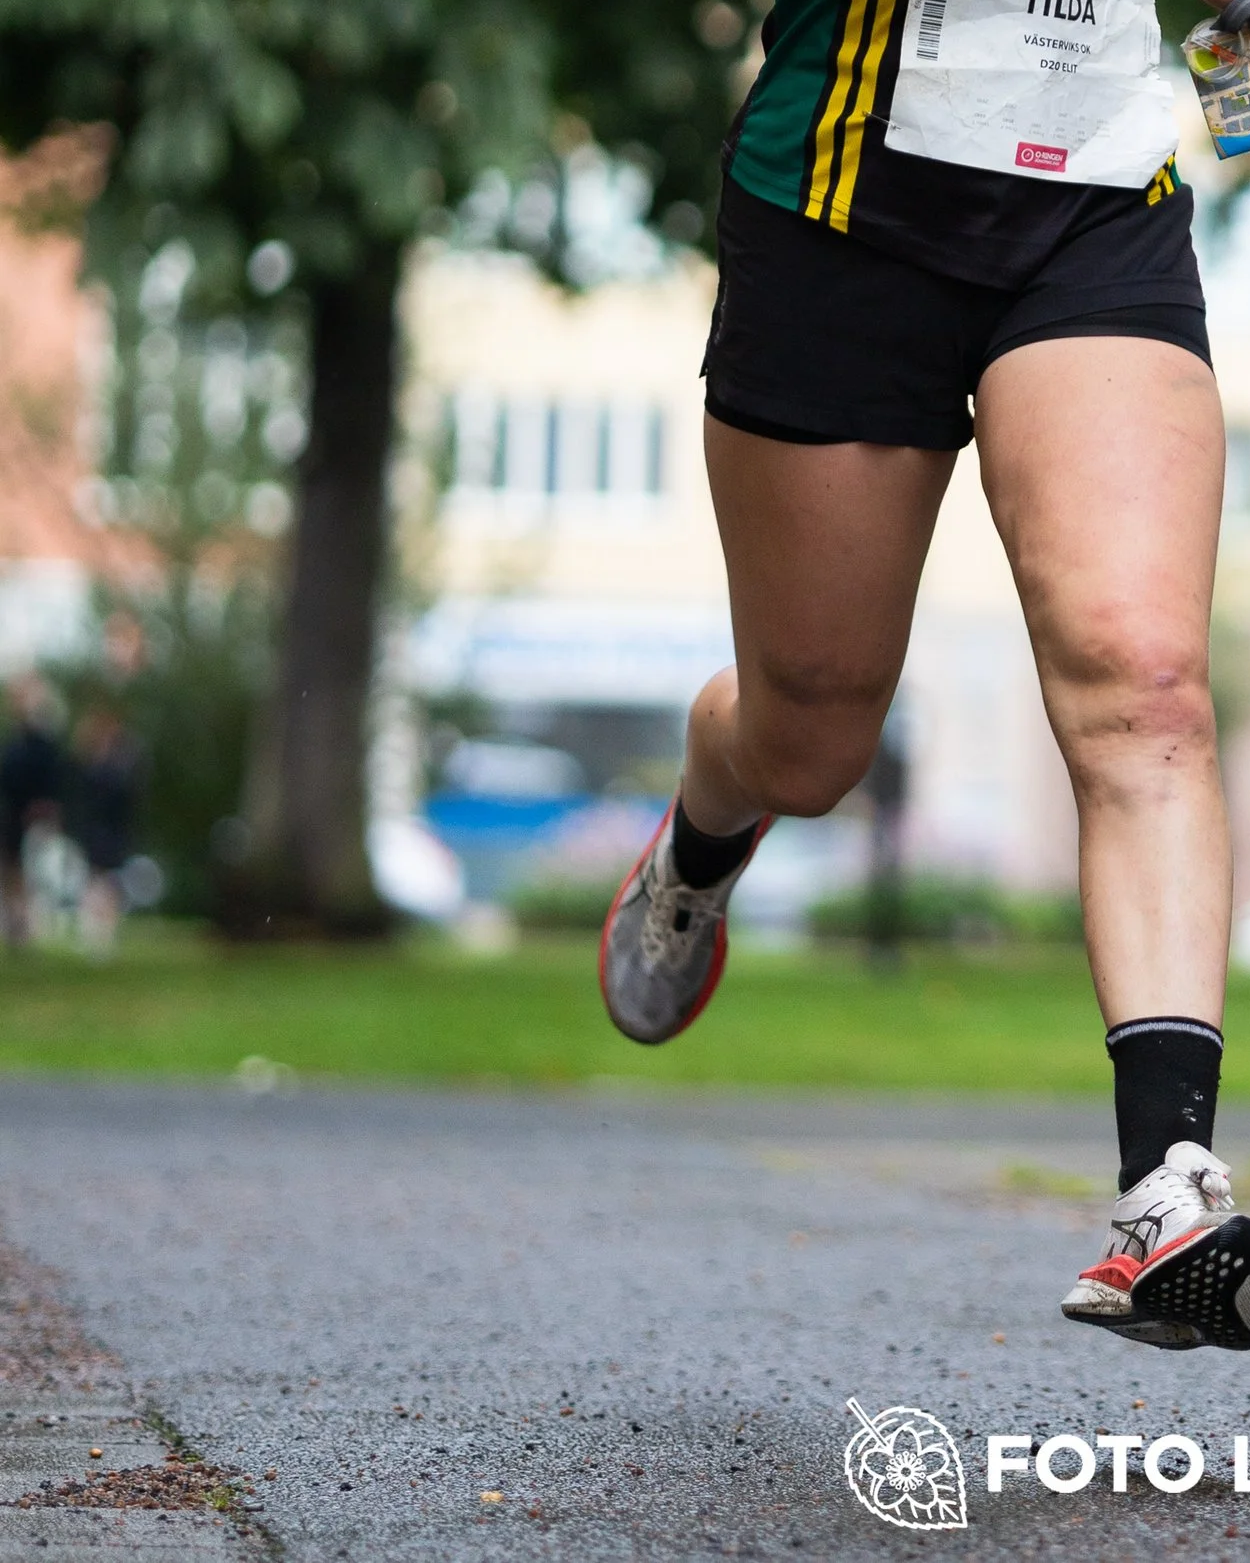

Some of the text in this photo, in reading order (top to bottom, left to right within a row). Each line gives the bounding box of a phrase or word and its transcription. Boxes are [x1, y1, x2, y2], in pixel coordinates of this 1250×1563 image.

[1024, 33, 1092, 55] VÄSTERVIKS OK
[1040, 59, 1078, 74] D20 ELIT
